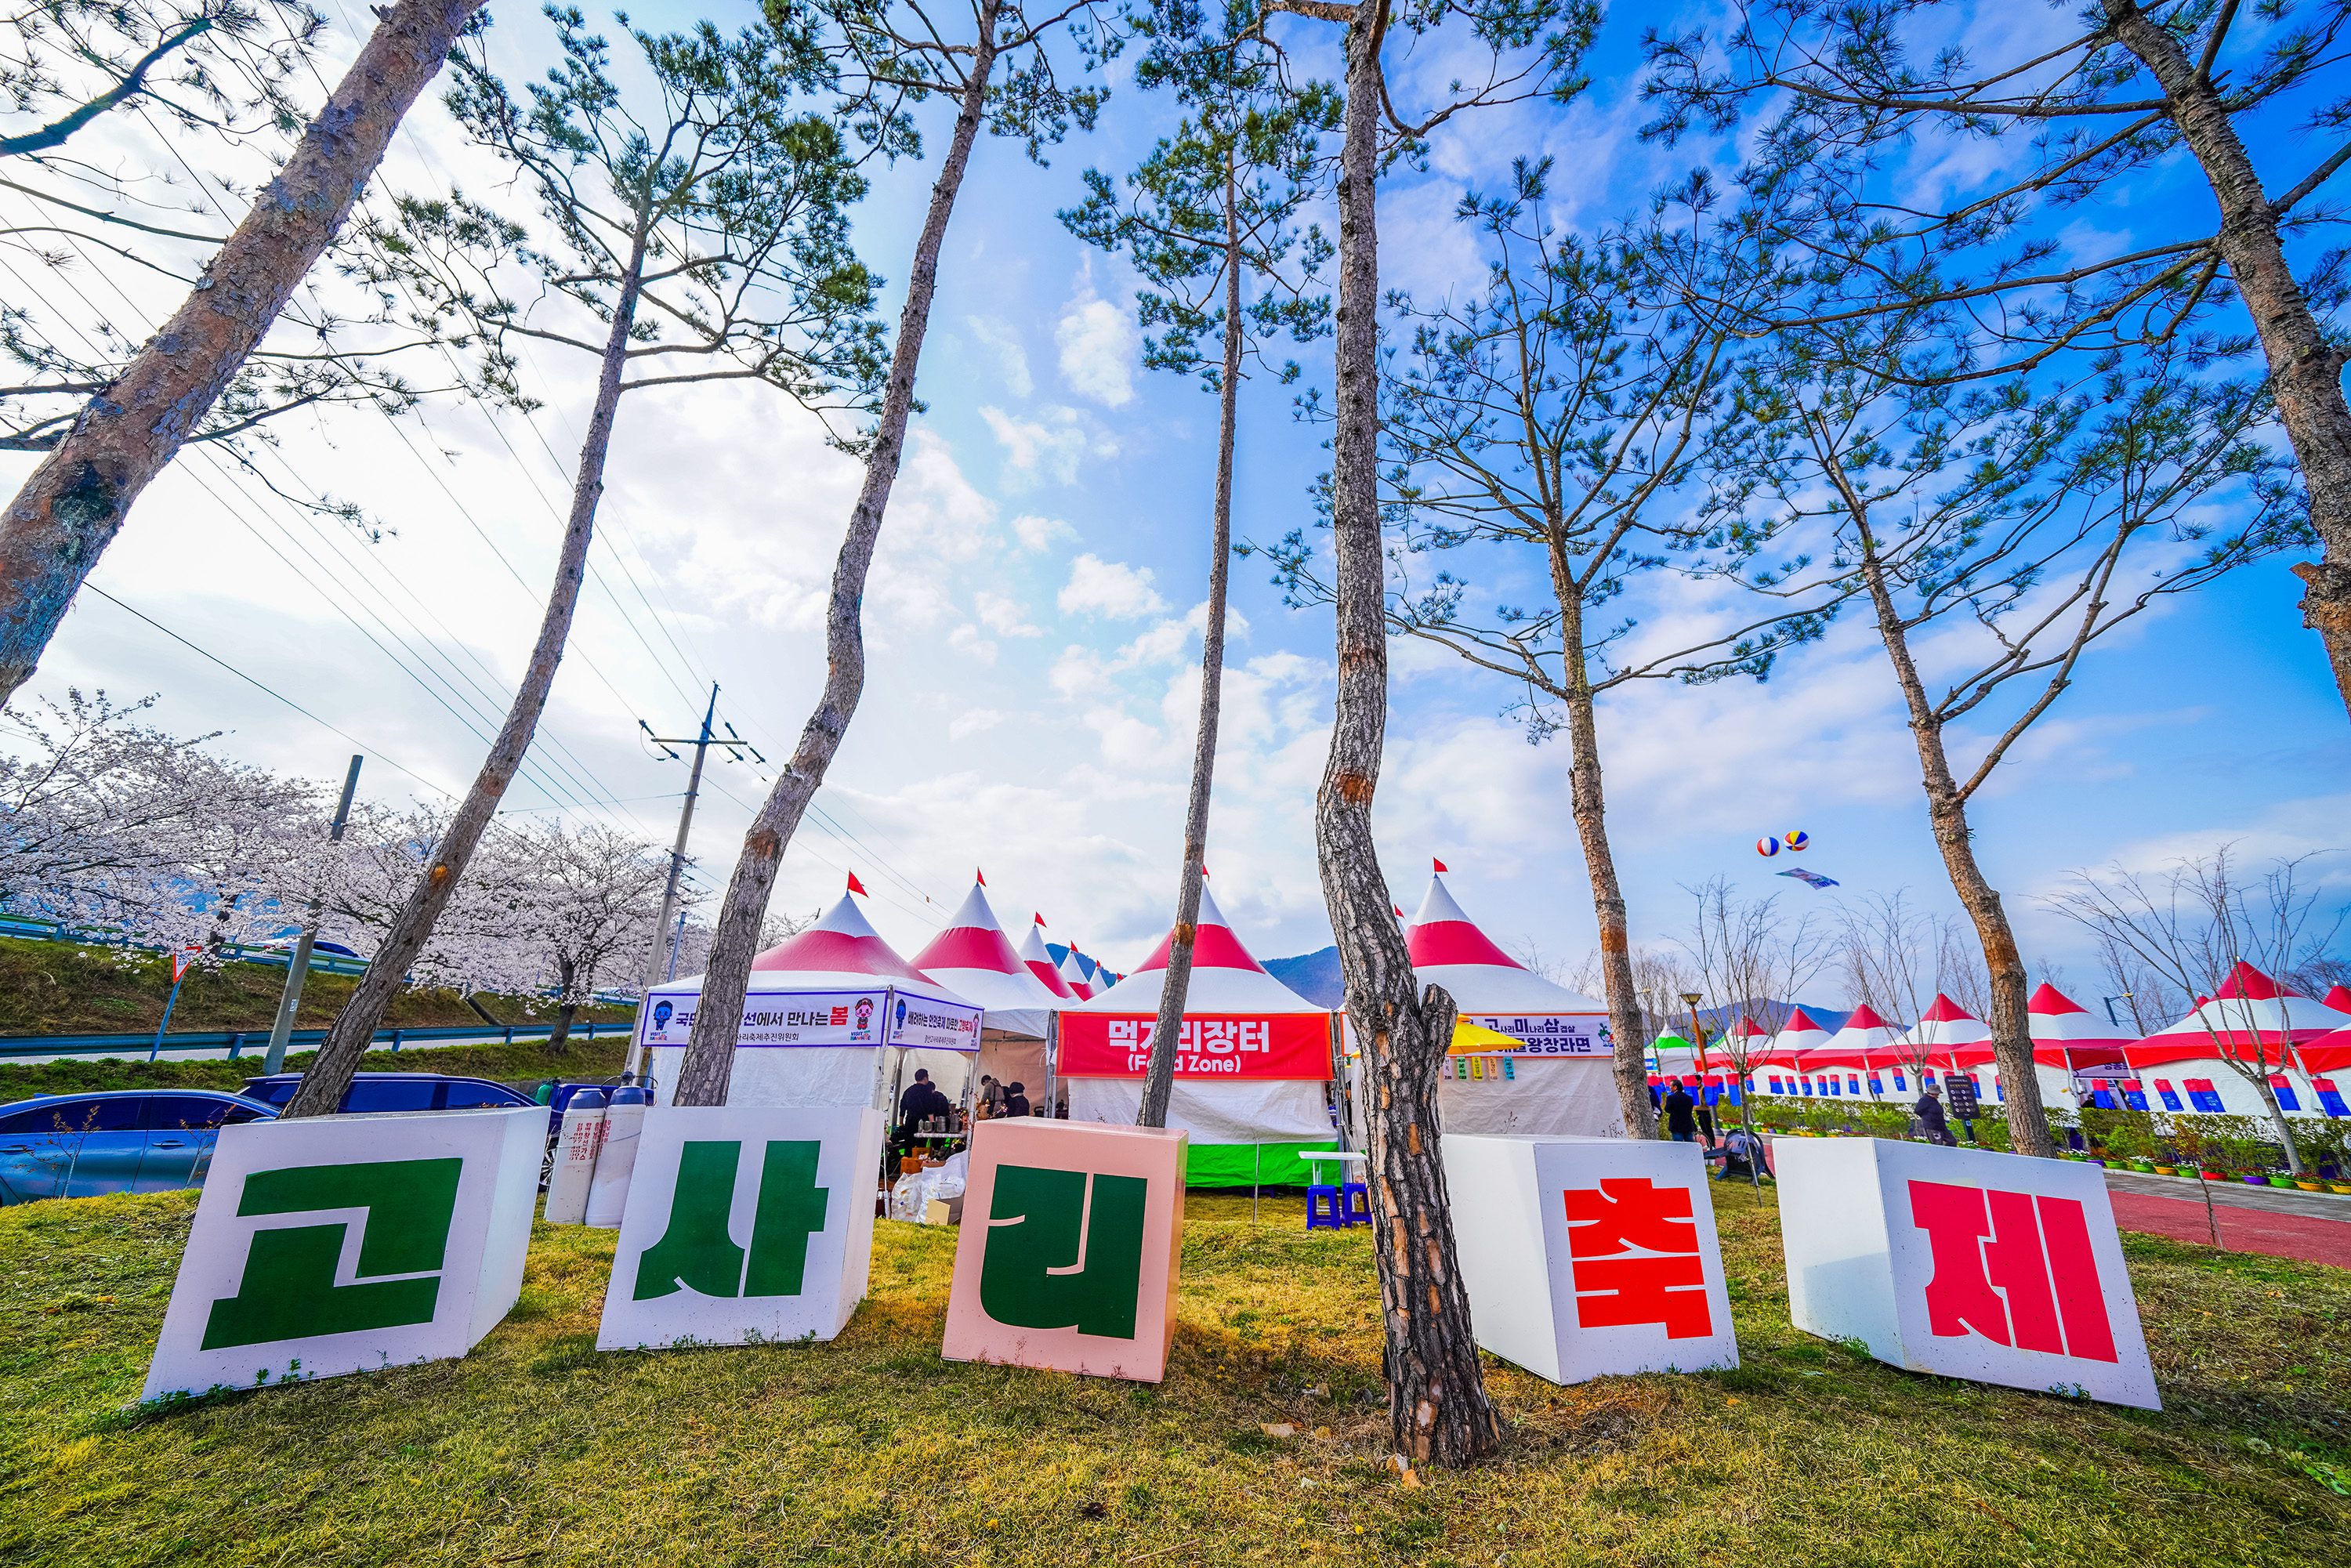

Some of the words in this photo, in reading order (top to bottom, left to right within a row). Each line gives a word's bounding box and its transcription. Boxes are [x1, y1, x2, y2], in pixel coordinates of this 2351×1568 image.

[741, 1012, 784, 1027] 선에서
[787, 1012, 828, 1027] 만나는
[830, 1006, 849, 1026] 봄
[1128, 1054, 1183, 1071] (Fd
[1188, 1055, 1241, 1073] Zone)
[201, 1158, 462, 1350] 고
[633, 1141, 828, 1300] 사
[981, 1164, 1147, 1339] 리
[1564, 1179, 1712, 1339] 축
[1907, 1179, 2119, 1363] 제
